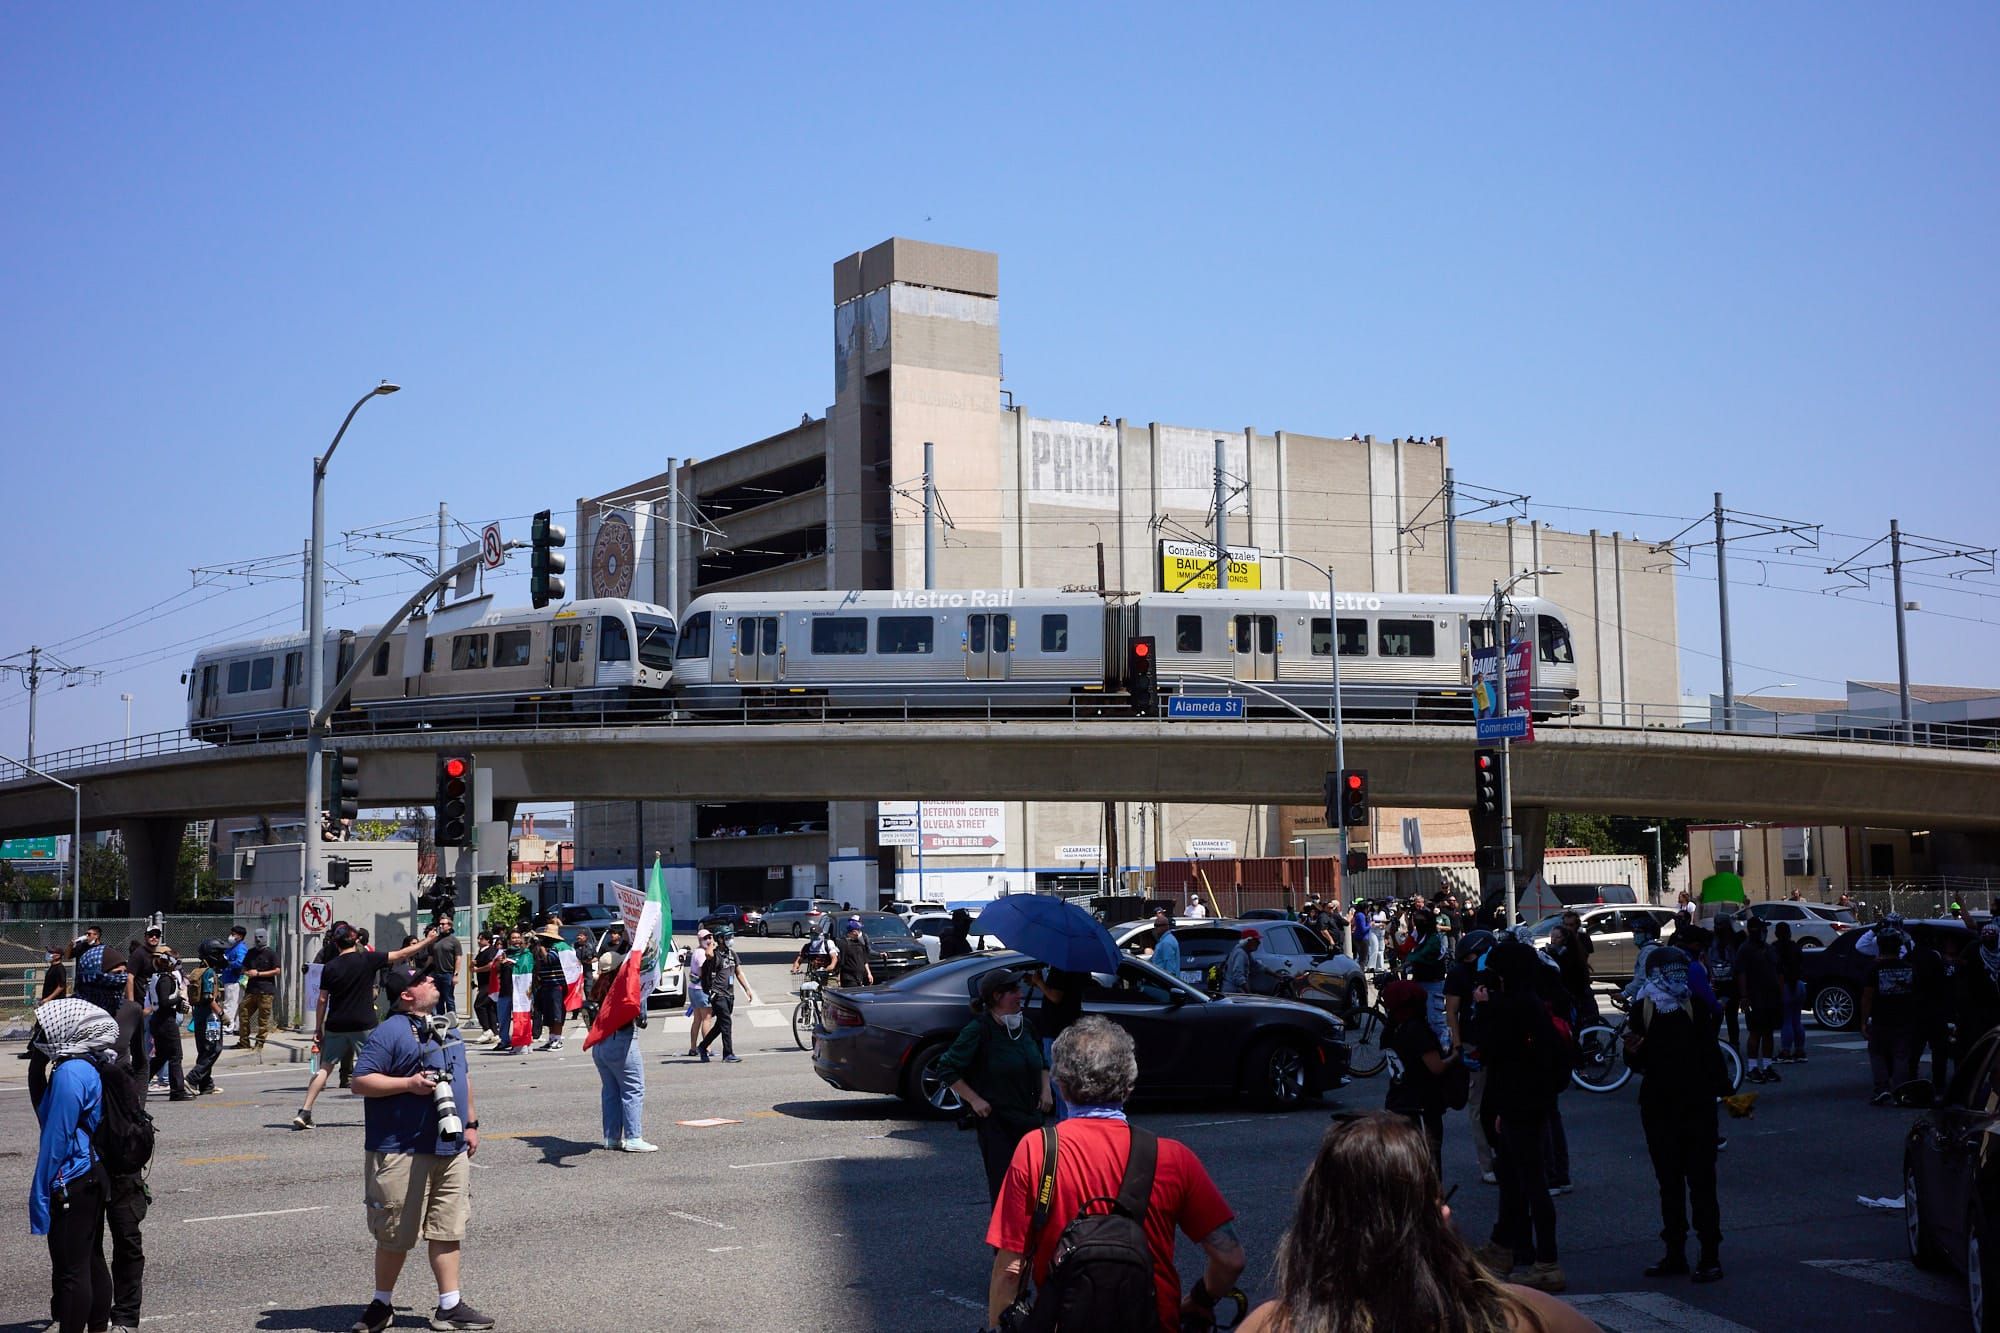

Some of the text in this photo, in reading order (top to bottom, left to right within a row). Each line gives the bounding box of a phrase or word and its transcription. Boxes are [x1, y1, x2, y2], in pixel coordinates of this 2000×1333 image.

[1031, 431, 1115, 496] PARK
[1168, 545, 1207, 558] Gonzales
[1176, 558, 1248, 575] BAIL BNDS
[1227, 575, 1249, 584] ONDS
[892, 589, 1014, 609] Metro Rail
[1307, 591, 1381, 611] Metro
[1472, 656, 1498, 676] GAME
[1175, 701, 1237, 712] Alameda St
[1480, 721, 1523, 734] Commercial
[922, 807, 1000, 817] DETENTION CENTER
[923, 819, 986, 829] OLVERA STREET
[932, 837, 984, 846] ENTER HERE
[1040, 1174, 1052, 1204] Nikon
